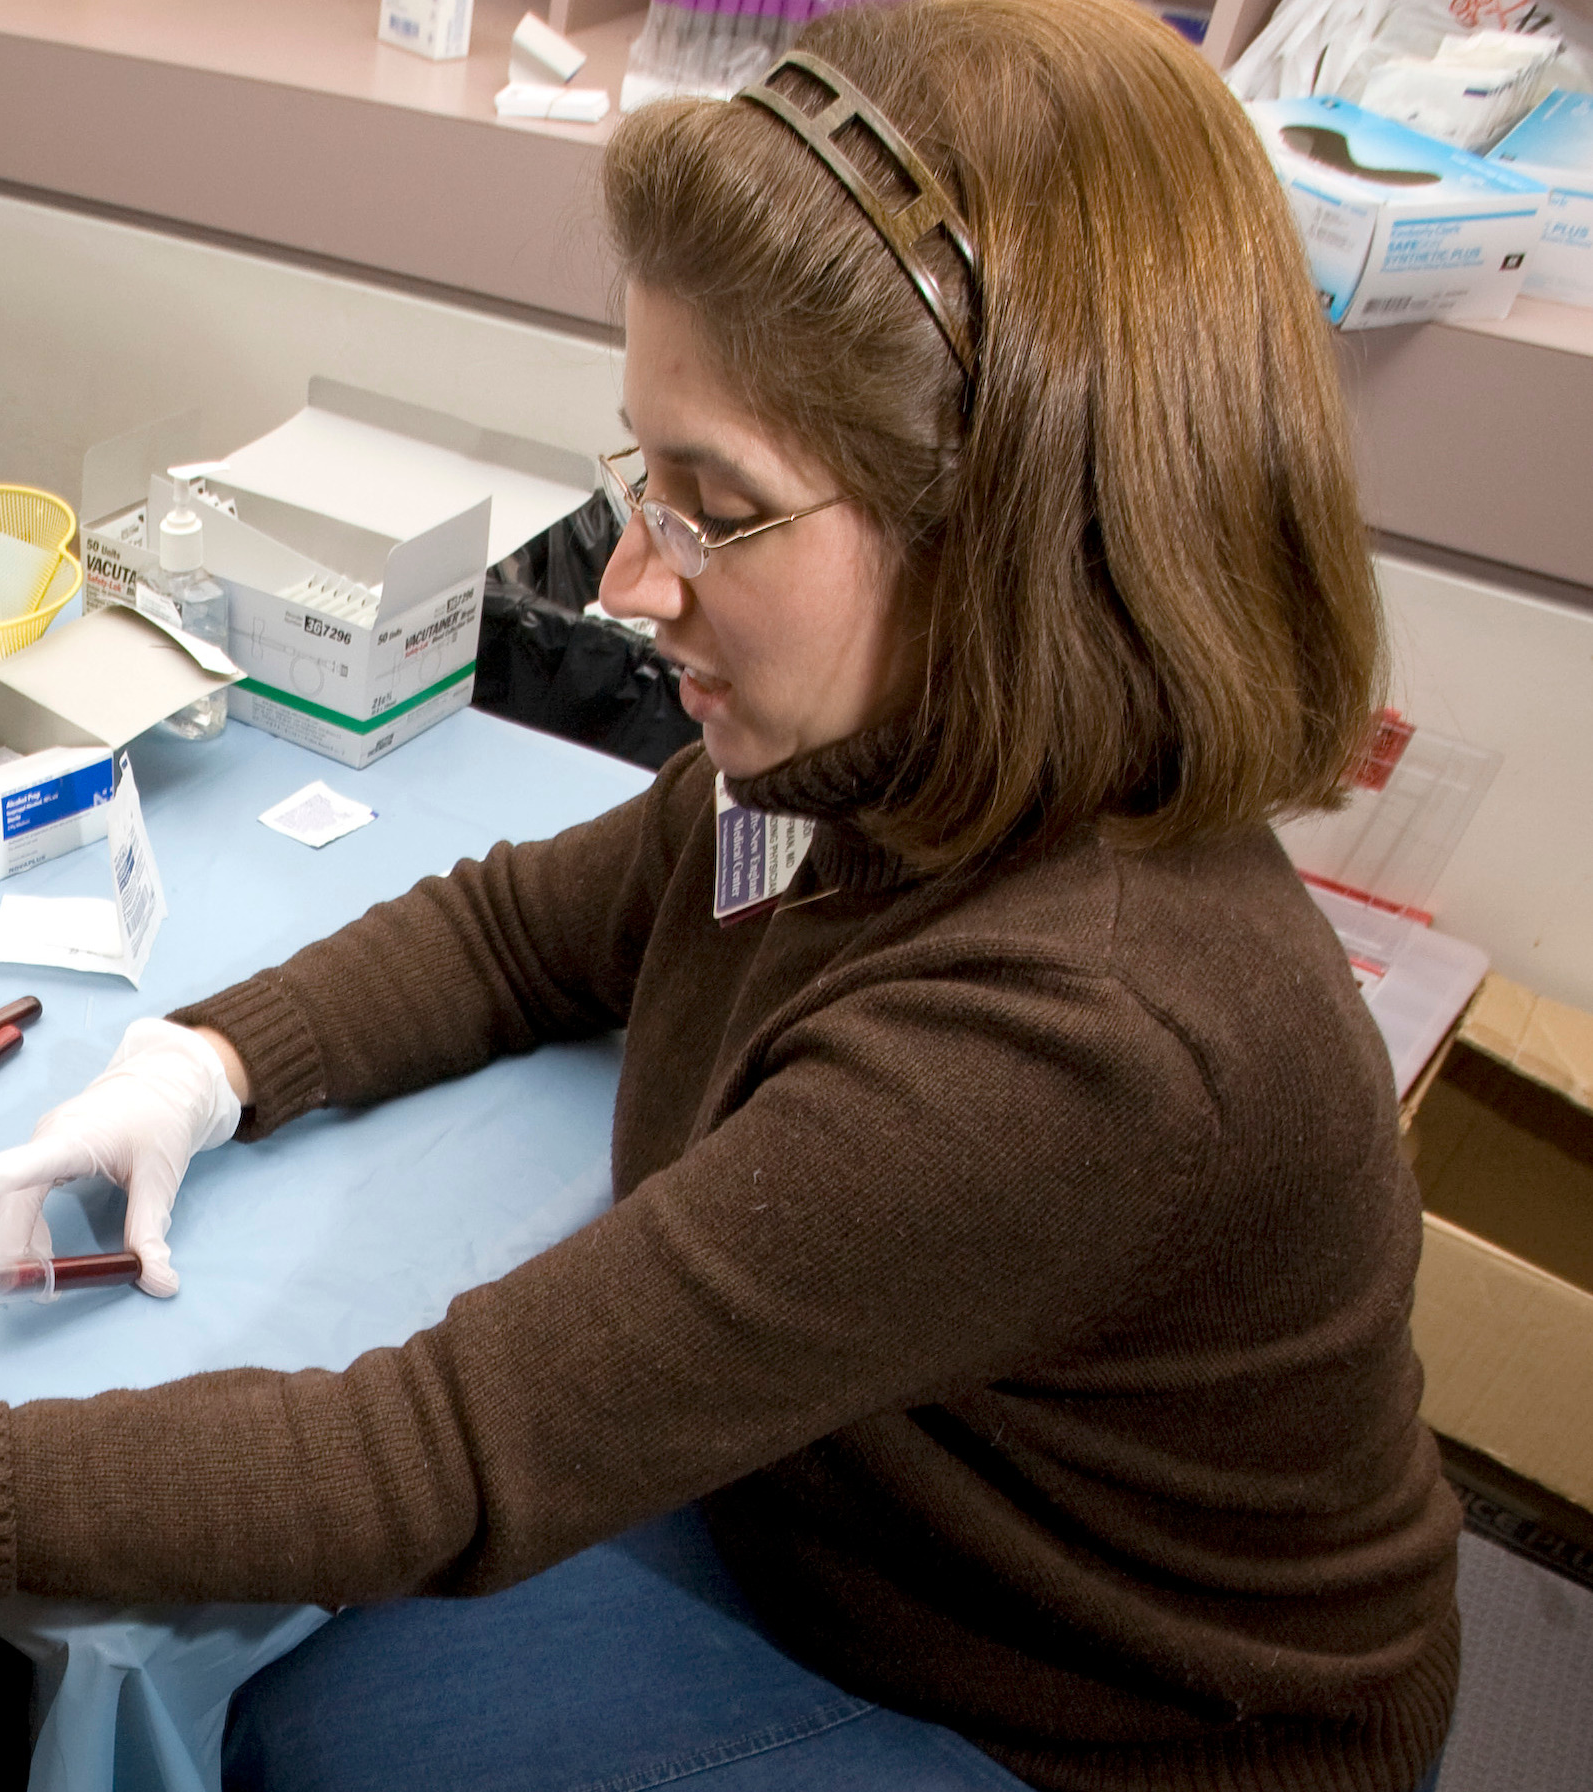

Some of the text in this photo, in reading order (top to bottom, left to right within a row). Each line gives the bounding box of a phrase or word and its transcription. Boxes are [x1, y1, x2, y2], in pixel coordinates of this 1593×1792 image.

[1451, 247, 1483, 260] PLUS
[87, 538, 120, 560] 50 Units
[87, 553, 137, 586] VACUTA
[304, 615, 352, 645] 367296
[377, 631, 388, 646] 50
[406, 612, 460, 651] VACUTAINER
[6, 791, 41, 809] Alcohol Prep
[731, 815, 744, 898] Medical Center
[748, 810, 761, 901] fts-New England
[768, 815, 778, 897] DING PHYSICIAN
[785, 817, 795, 869] FMAN, MD
